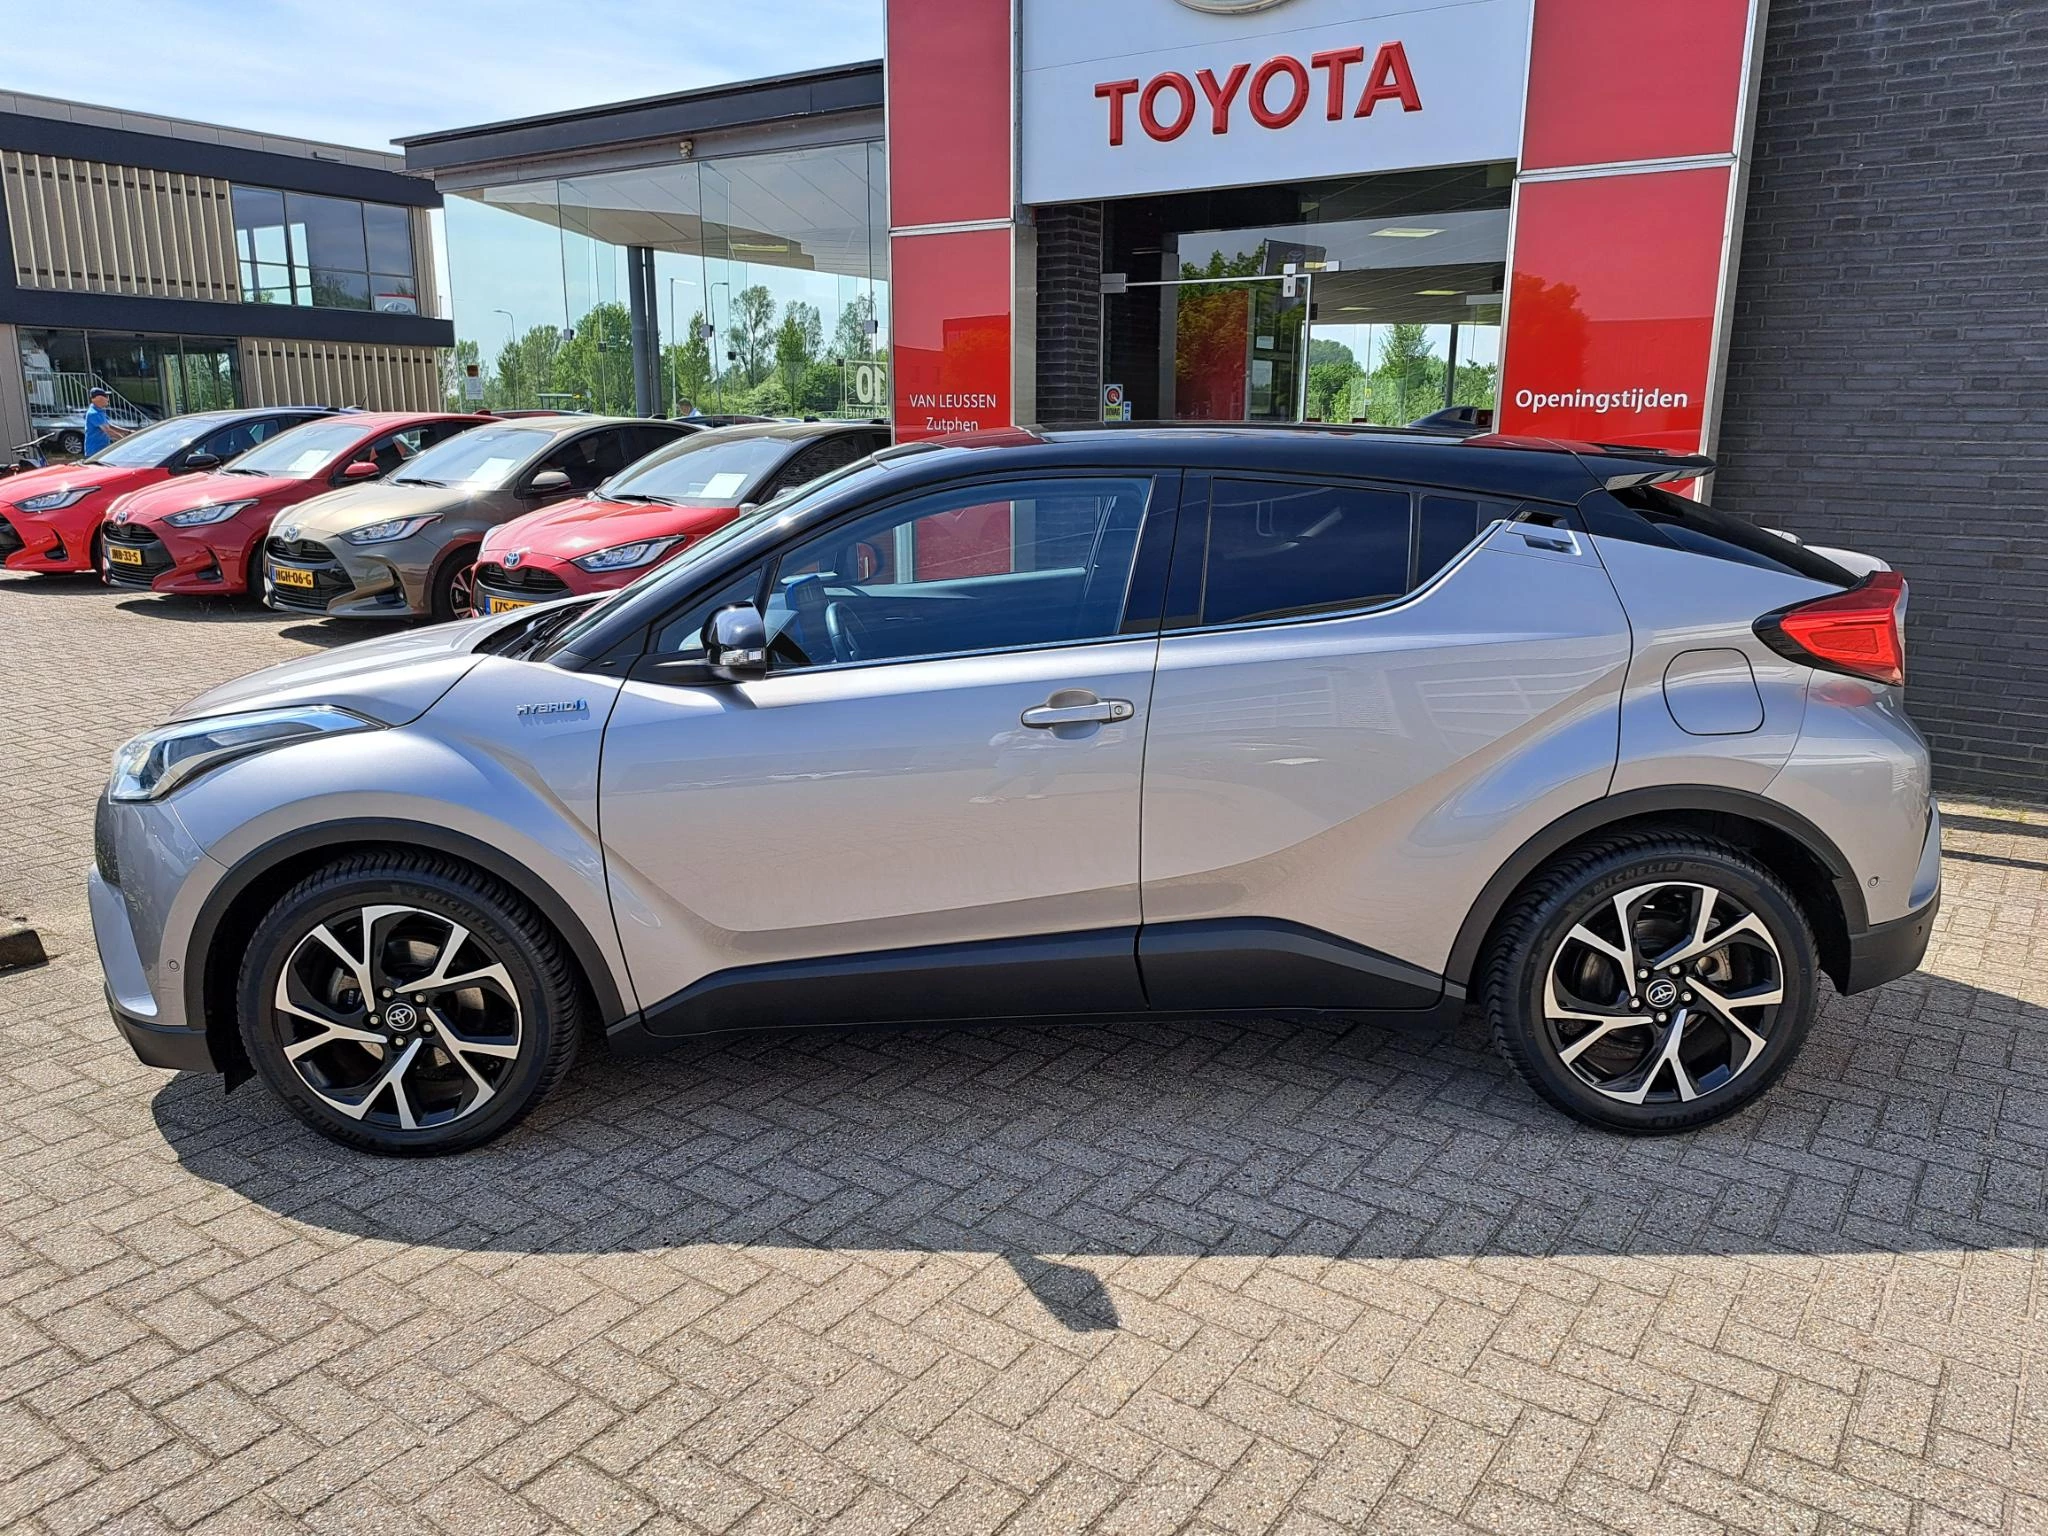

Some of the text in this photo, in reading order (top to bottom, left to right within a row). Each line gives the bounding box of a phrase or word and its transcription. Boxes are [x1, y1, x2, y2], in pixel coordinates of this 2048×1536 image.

[1094, 41, 1423, 146] TOYOTA
[909, 394, 996, 409] VAN LEUSSEN
[1515, 388, 1688, 414] Openingstijden
[926, 416, 979, 435] Zutphen
[516, 701, 576, 716] HYBRID
[1592, 862, 1685, 896] MICHELIN
[423, 892, 506, 945] MICHELIN
